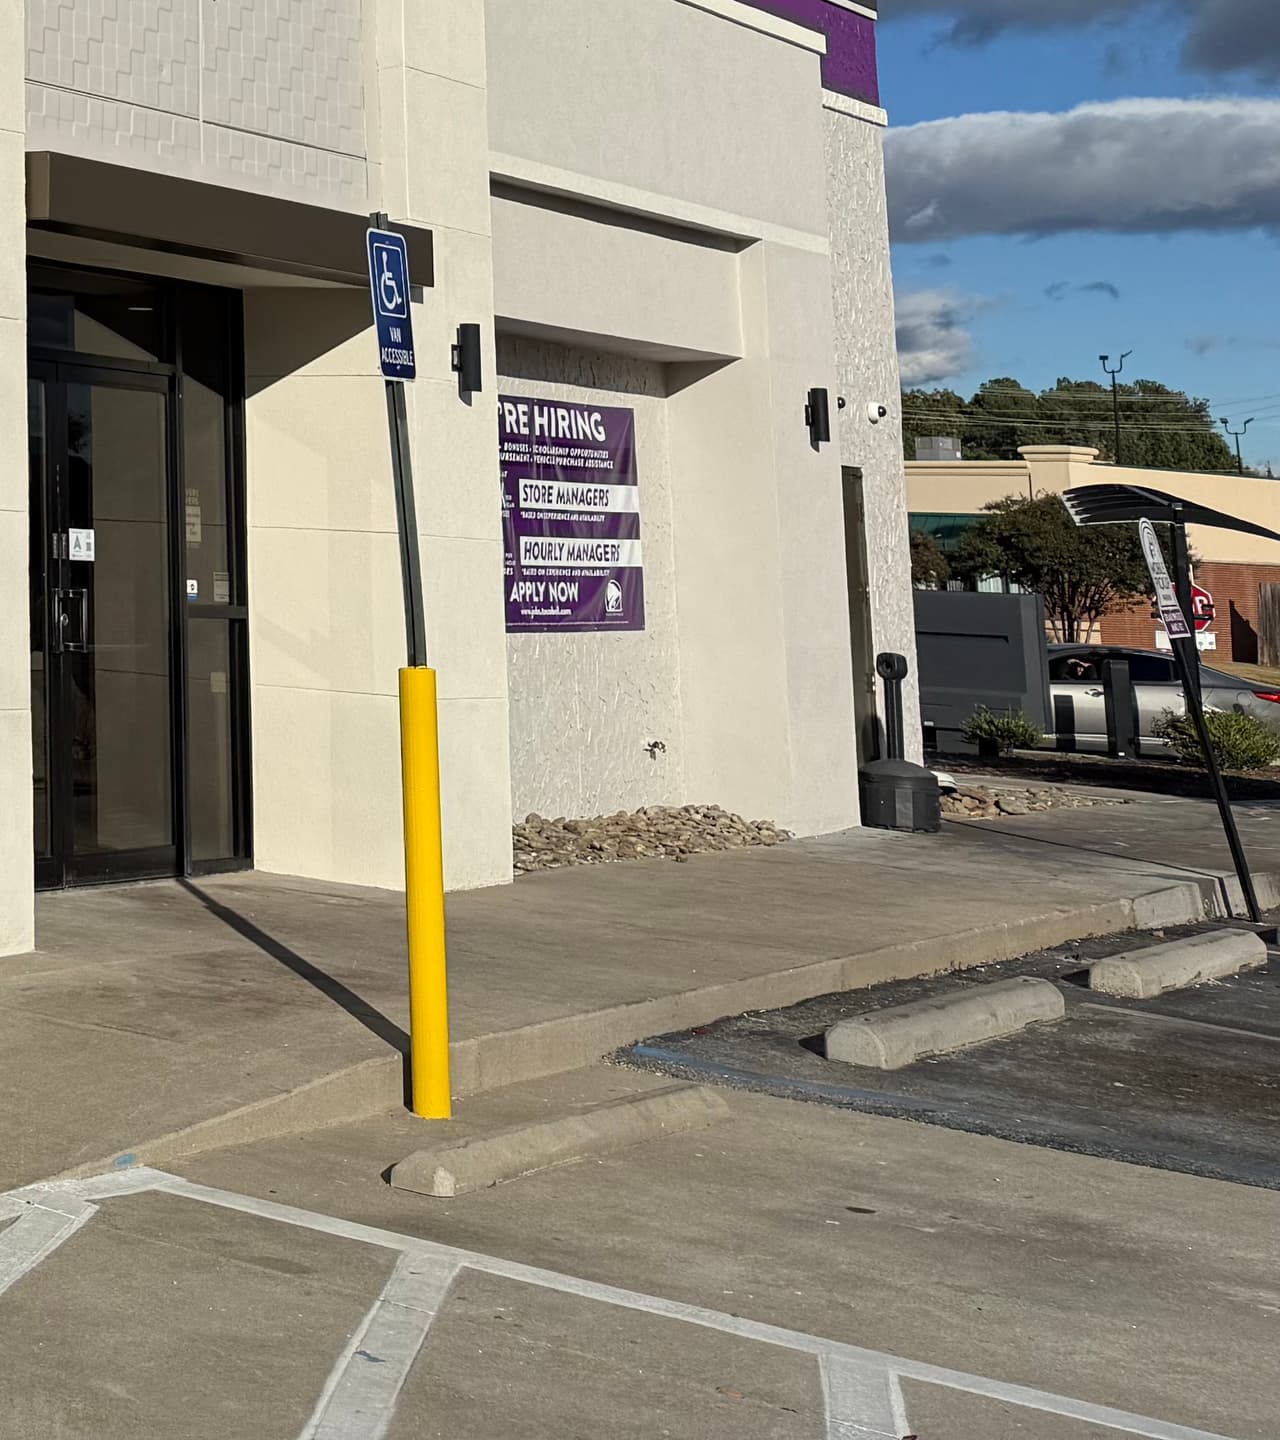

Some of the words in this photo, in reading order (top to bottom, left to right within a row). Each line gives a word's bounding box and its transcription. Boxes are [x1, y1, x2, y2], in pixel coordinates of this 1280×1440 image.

[389, 326, 401, 343] VAN
[382, 347, 414, 366] ACCESSIBLE
[533, 405, 606, 441] HIRING
[523, 484, 553, 504] STORE
[557, 488, 609, 507] MANAGERS
[524, 541, 565, 562] HOURLY
[567, 544, 620, 562] MANAGERS
[510, 581, 546, 602] APPLY
[549, 582, 579, 602] NOW
